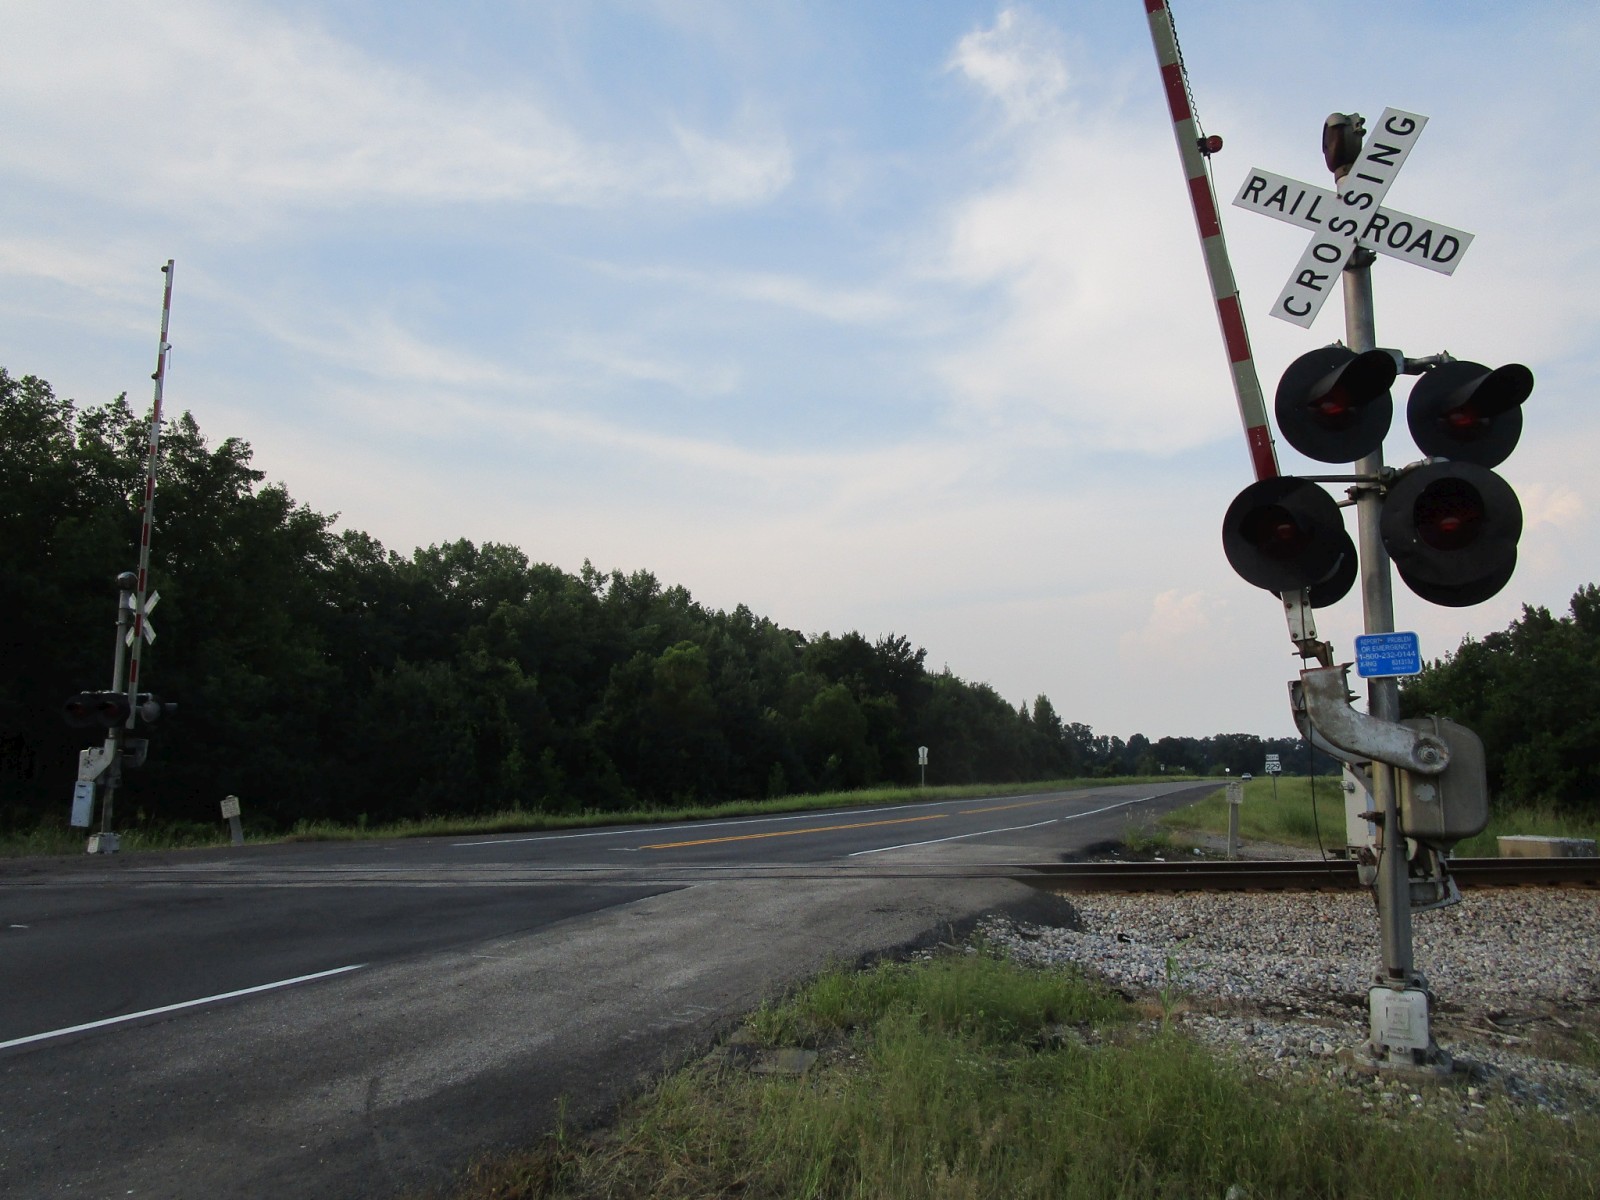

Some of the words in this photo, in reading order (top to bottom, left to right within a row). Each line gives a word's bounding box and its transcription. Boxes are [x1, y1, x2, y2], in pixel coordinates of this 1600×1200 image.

[1242, 175, 1323, 224] RAIL
[1361, 213, 1460, 263] ROAD
[1283, 116, 1416, 316] CROSSING
[1359, 650, 1416, 660] 1-800-232-0144
[1372, 643, 1411, 652] EMERGENCY
